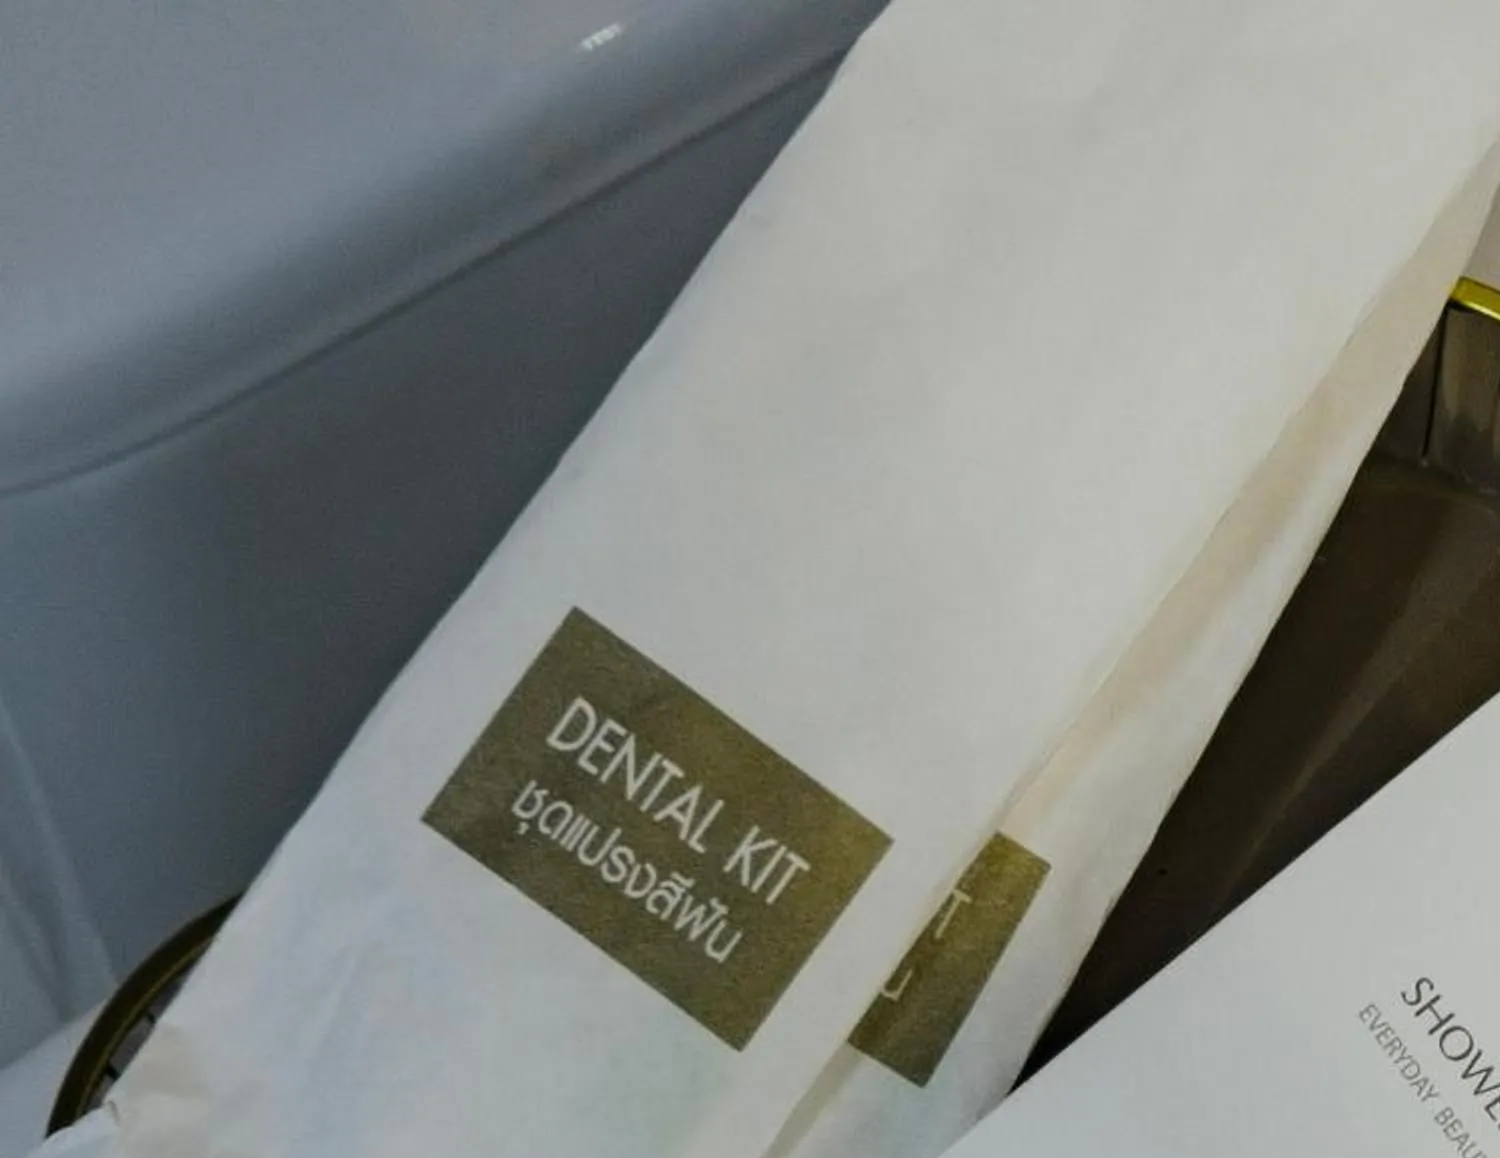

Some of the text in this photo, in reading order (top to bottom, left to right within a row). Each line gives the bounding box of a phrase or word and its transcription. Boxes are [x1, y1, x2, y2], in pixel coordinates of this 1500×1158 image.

[511, 780, 743, 963] ชุดแปรงสีฟัน
[546, 696, 811, 904] DENTAL KIT
[1358, 1003, 1440, 1103] EVERYDAY
